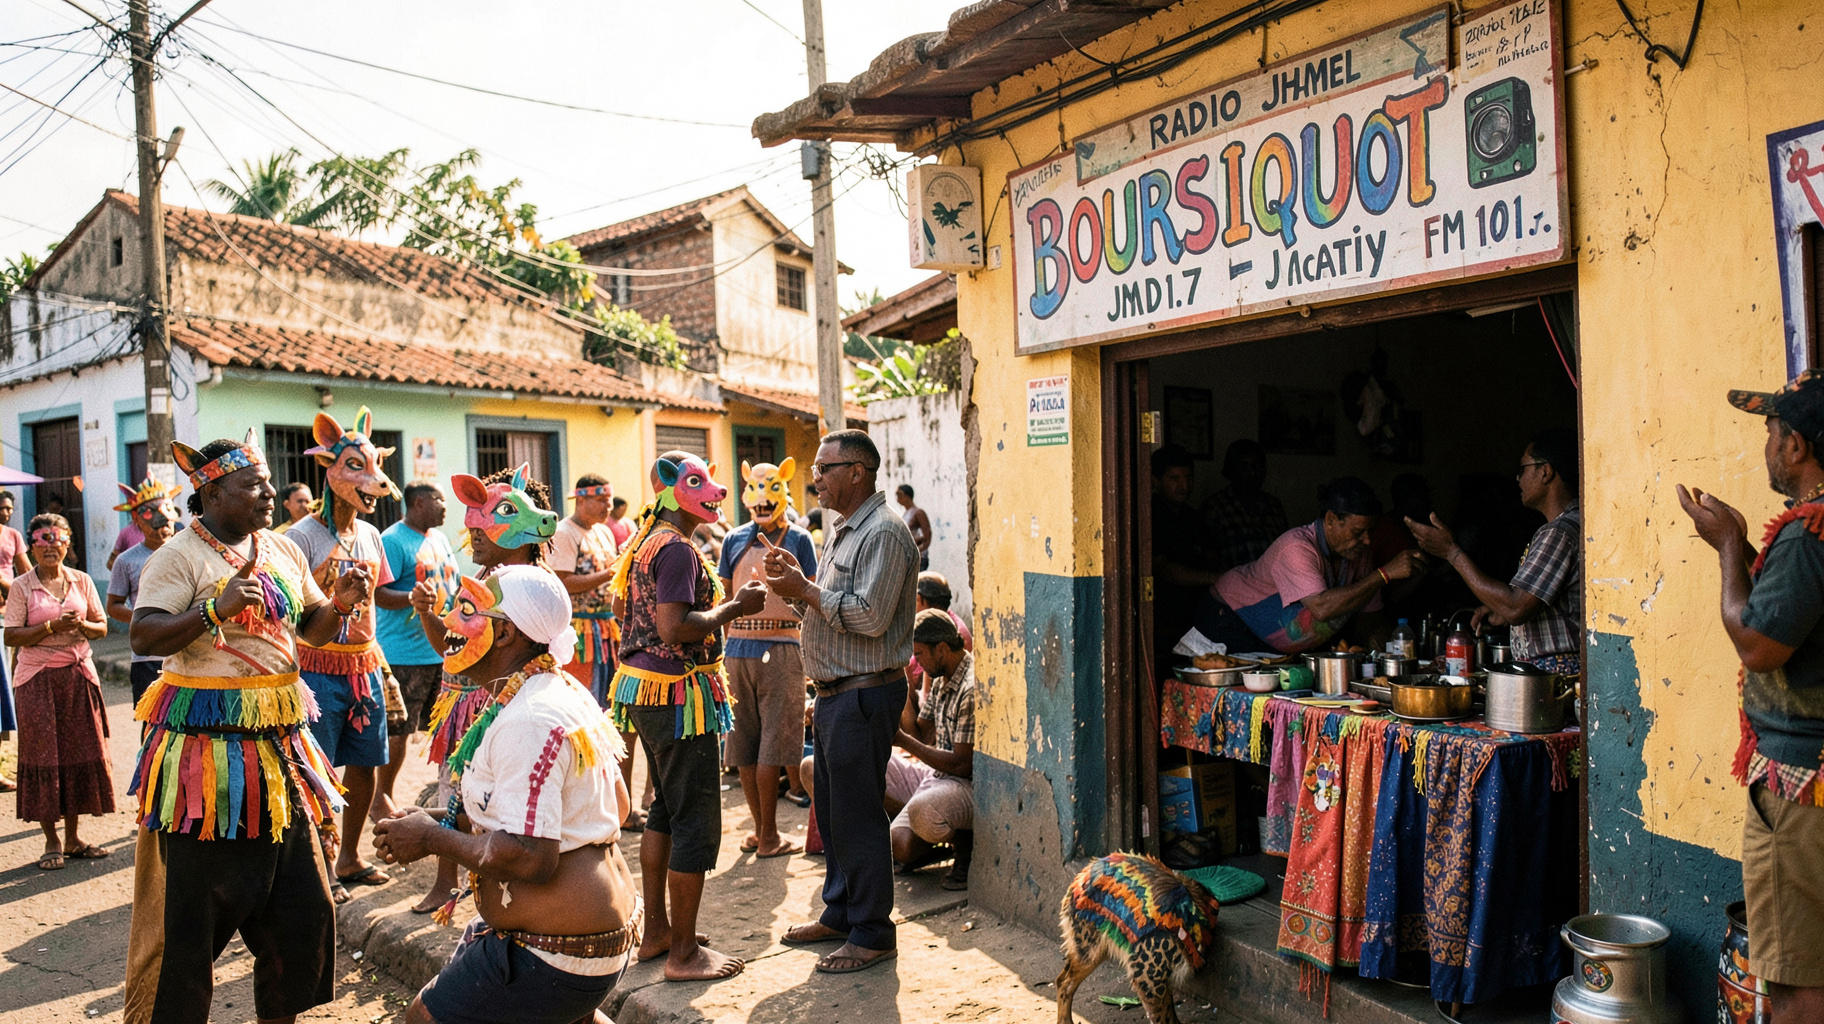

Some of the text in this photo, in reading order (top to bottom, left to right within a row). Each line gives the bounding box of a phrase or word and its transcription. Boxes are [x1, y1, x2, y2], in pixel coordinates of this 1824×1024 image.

[1149, 89, 1242, 150] RADIO
[1028, 75, 1449, 320] BOURSIQUOT
[1424, 210, 1465, 259] FM
